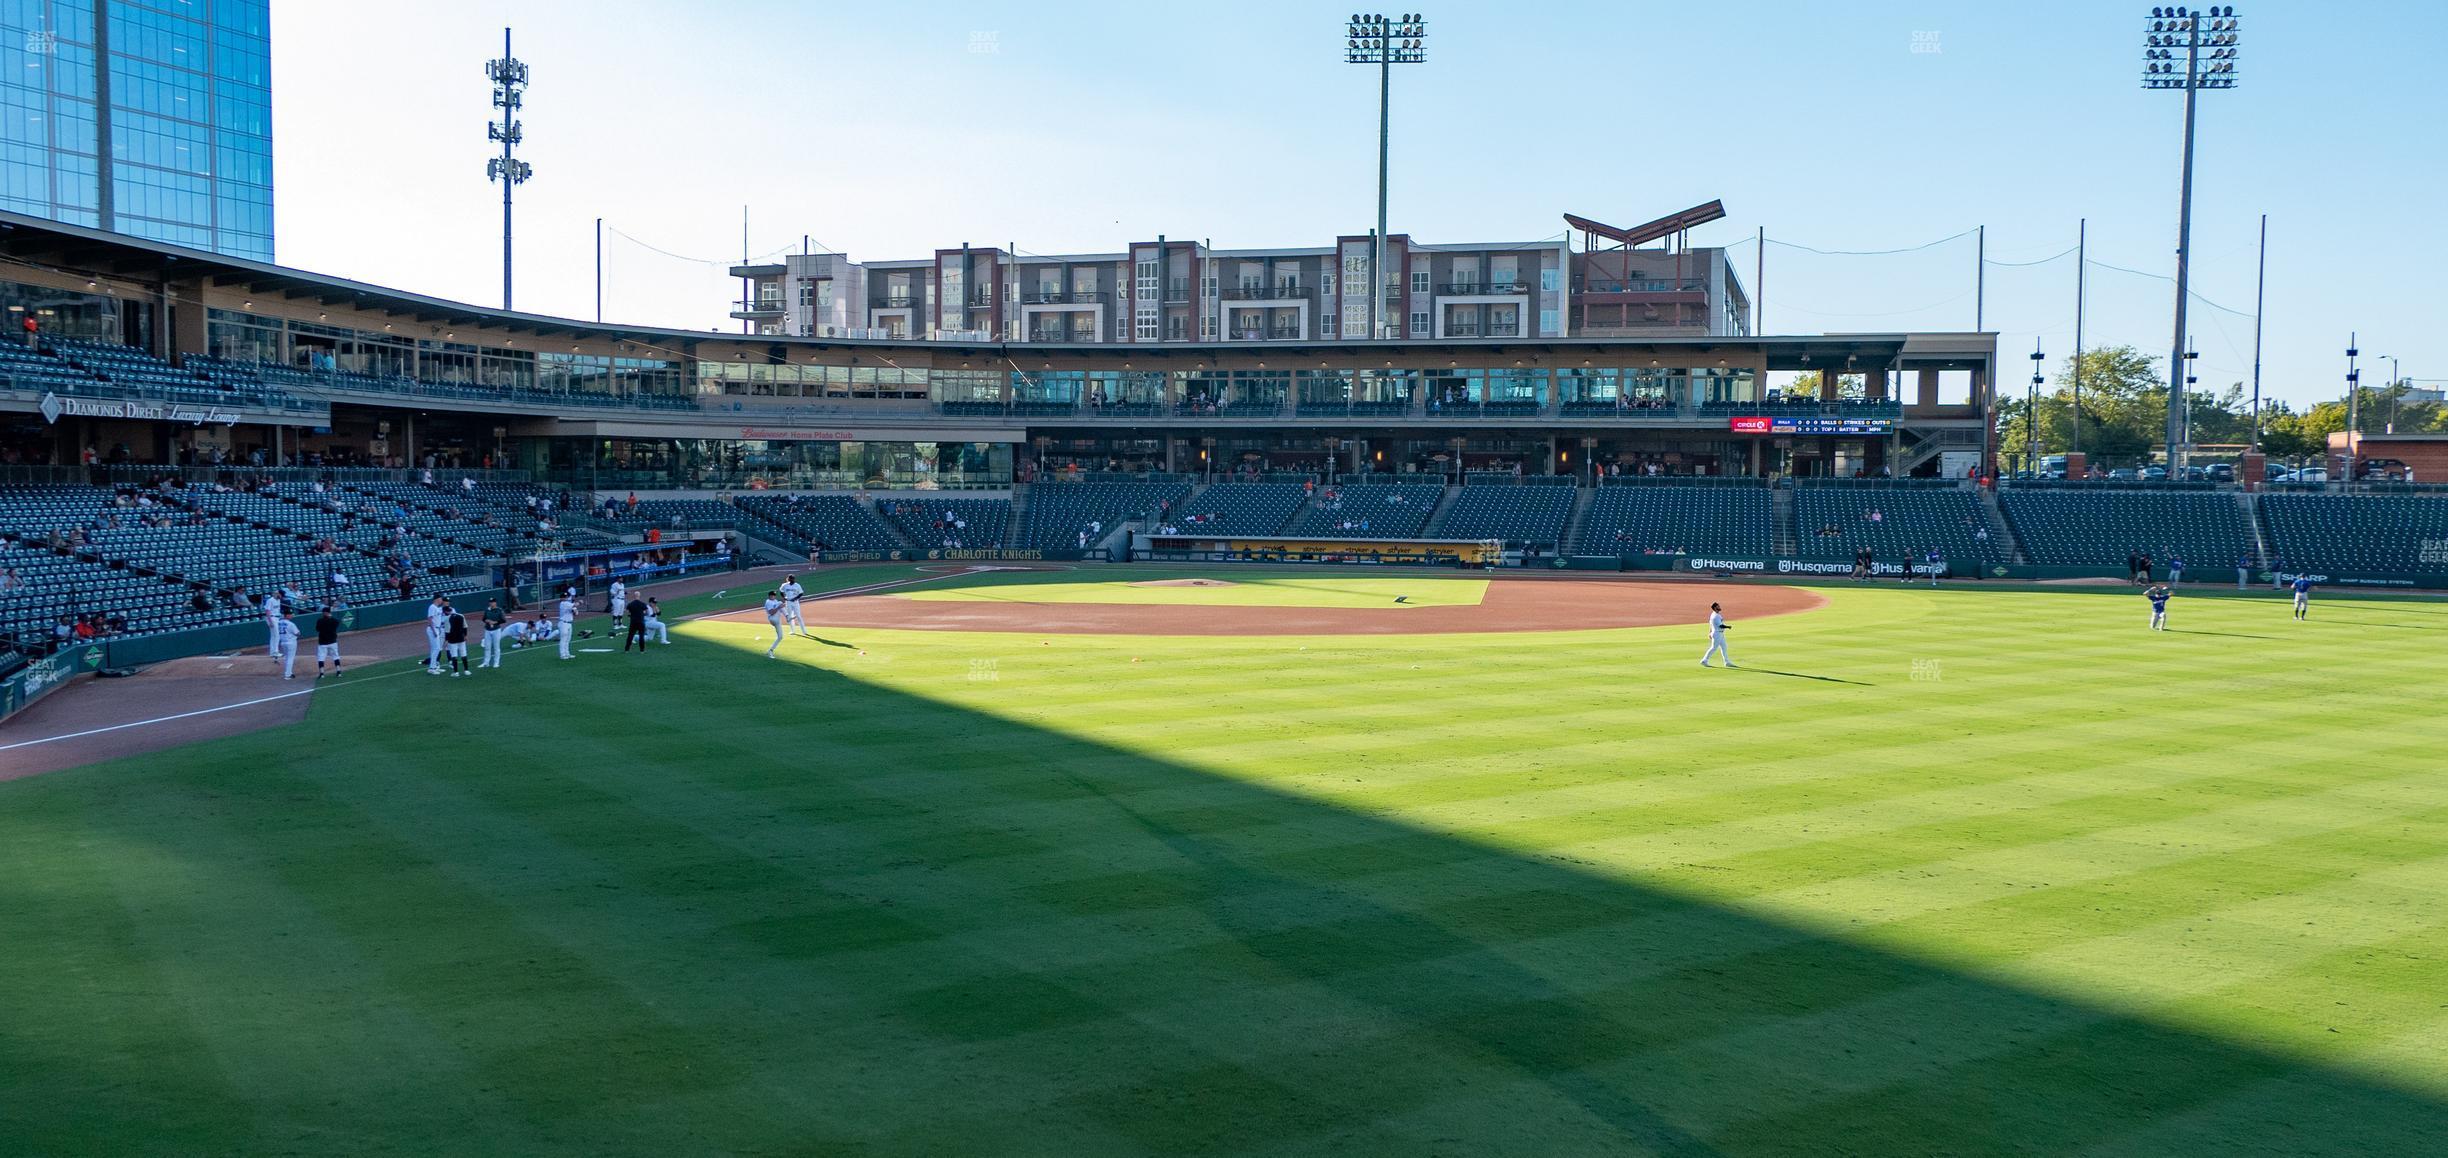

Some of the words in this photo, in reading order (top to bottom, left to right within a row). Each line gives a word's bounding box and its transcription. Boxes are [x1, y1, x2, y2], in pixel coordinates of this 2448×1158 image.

[65, 399, 123, 417] DIAMONDS
[126, 402, 163, 419] DIRECT
[167, 404, 205, 425] Luxury
[205, 406, 242, 427] Lounge
[791, 431, 812, 439] Home
[814, 431, 833, 439] Plate
[834, 431, 853, 439] Club
[860, 552, 880, 560] FIELD
[944, 549, 1000, 560] CHARLOTTE
[1002, 550, 1043, 560] KNIGHTS
[1704, 559, 1764, 570] Husqvarna
[1791, 561, 1853, 573] Husqvarna
